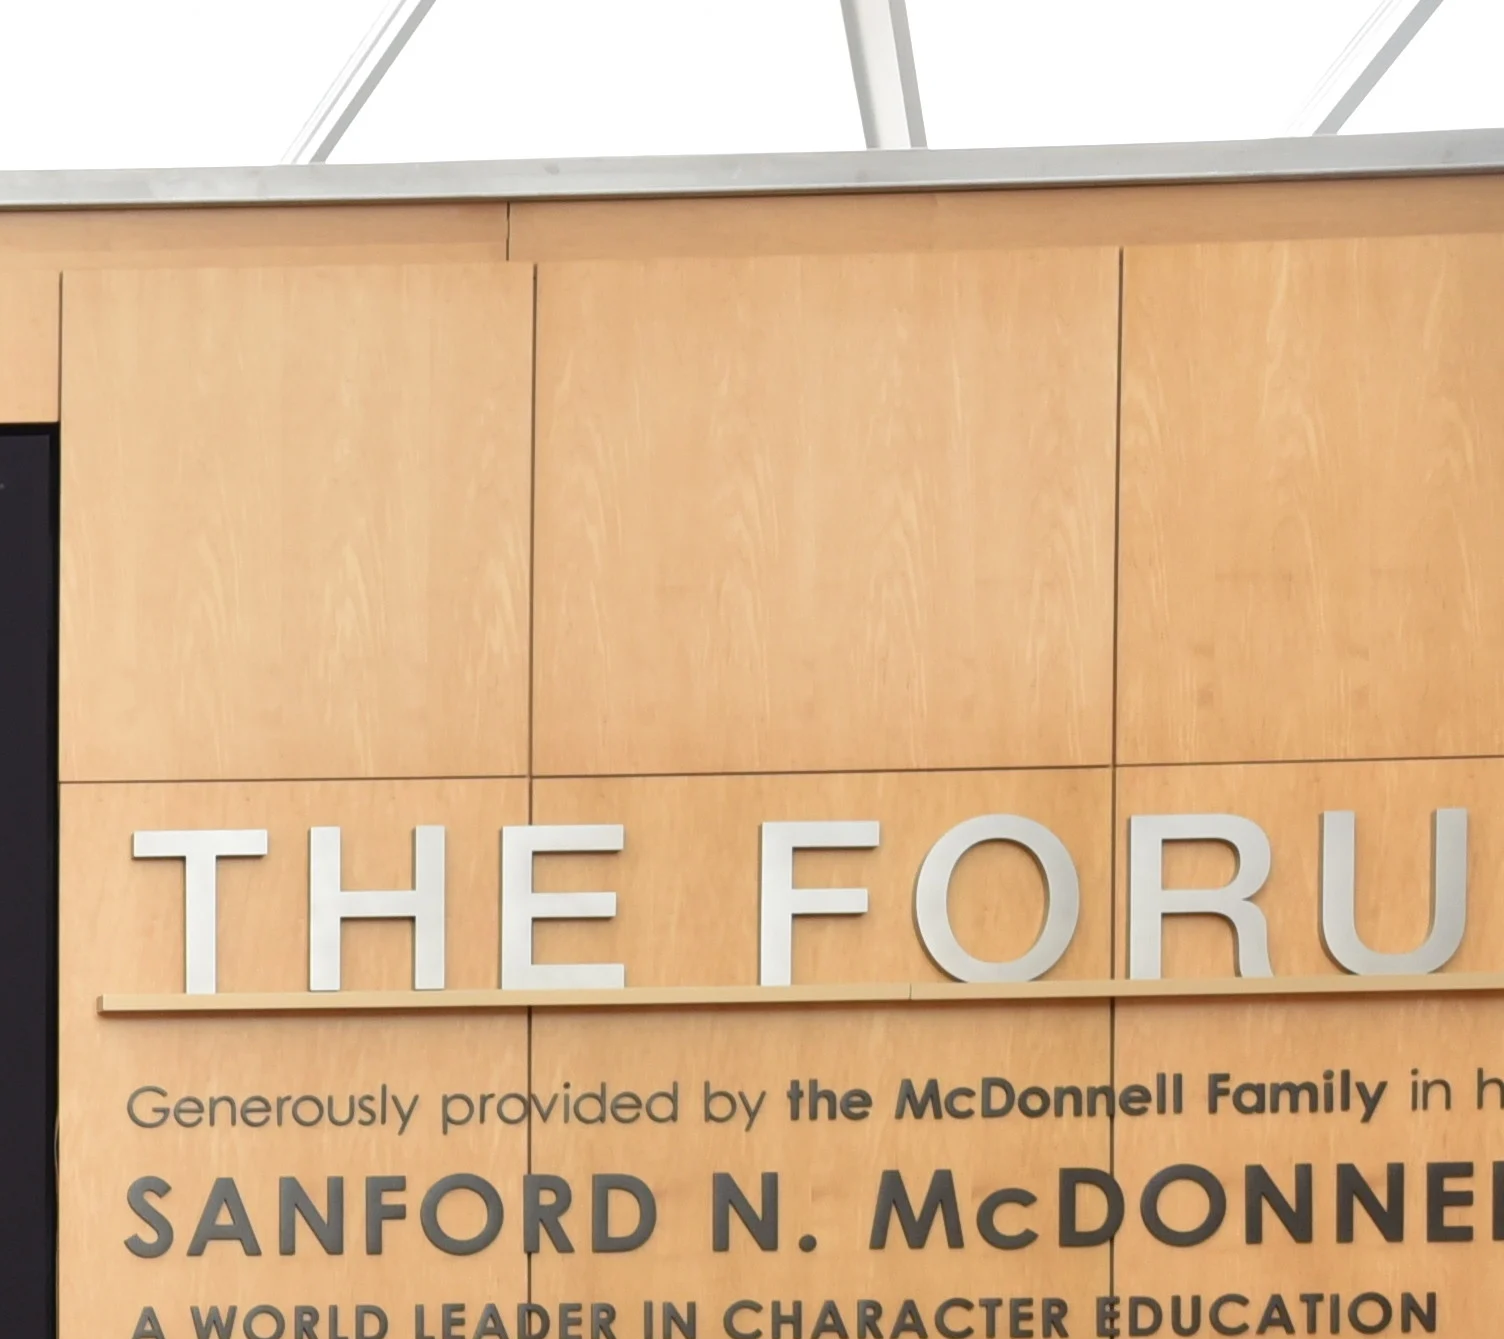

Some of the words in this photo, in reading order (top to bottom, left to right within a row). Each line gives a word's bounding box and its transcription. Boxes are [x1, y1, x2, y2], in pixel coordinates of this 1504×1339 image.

[131, 823, 626, 995] THE
[759, 807, 1469, 986] FORU
[126, 1083, 419, 1136] Generously
[441, 1081, 678, 1135] provided
[702, 1080, 767, 1132] by
[788, 1079, 872, 1121] the
[894, 1072, 1183, 1121] McDonnell
[1207, 1069, 1388, 1123] Family
[1410, 1068, 1451, 1112] in
[123, 1173, 657, 1259] SANFORD
[712, 1171, 817, 1253] N.
[869, 1162, 1504, 1251] McDONNE
[1095, 1292, 1437, 1339] EDUCATION
